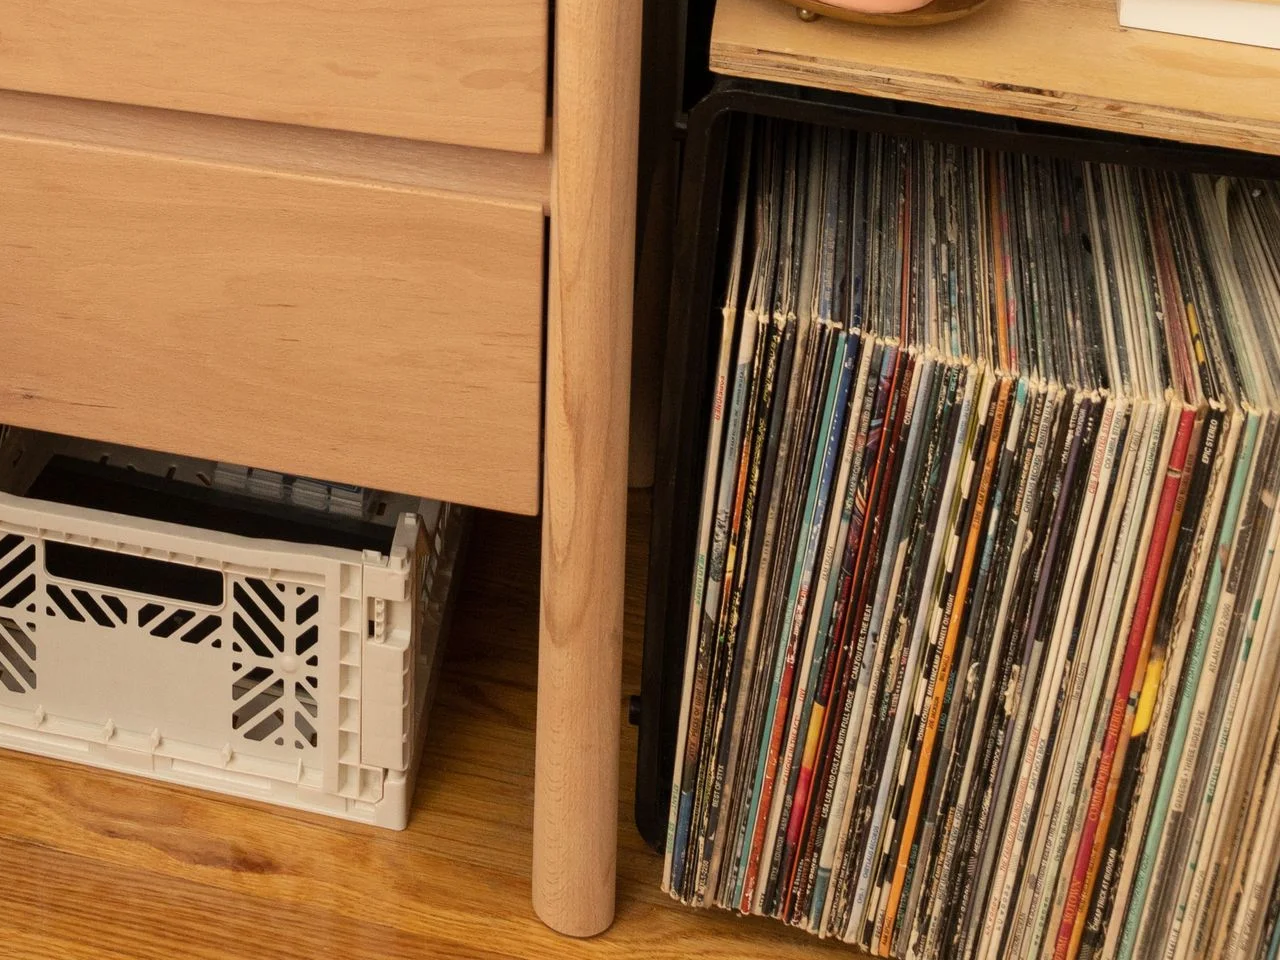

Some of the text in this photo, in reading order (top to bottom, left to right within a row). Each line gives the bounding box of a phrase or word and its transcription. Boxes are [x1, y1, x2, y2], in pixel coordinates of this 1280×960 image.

[1028, 423, 1038, 442] MADE
[1030, 453, 1041, 480] RECORDS
[1037, 422, 1048, 448] PRINTED
[1060, 428, 1074, 463] COLUMBIA
[1087, 406, 1113, 493] CBS ASSOCIATED STEREO
[1103, 409, 1123, 469] COLUMBIA STEREO
[1200, 417, 1218, 464] EPIC STEREO
[860, 621, 868, 634] THE
[862, 603, 872, 621] BEAT
[853, 650, 862, 665] YOU
[856, 634, 865, 650] FEEL
[1207, 637, 1223, 673] ATLANTIC
[916, 719, 926, 740] JOHN
[926, 655, 940, 695] MELLENCAMP
[936, 626, 947, 649] LONELY
[944, 593, 954, 614] NIGHT
[983, 738, 995, 769] HOWARD
[1006, 628, 1019, 660] ACTION
[821, 689, 854, 818] LISA LISA AND CULT JAM WITH FULL FORCE
[1032, 754, 1041, 772] HOLD
[1036, 737, 1045, 755] BACK
[1087, 753, 1112, 821] COMMODORES
[1107, 696, 1125, 736] HEROES
[1174, 709, 1205, 808] GENESIS THREE SIDES LIVE
[711, 762, 724, 807] BEST OF STYX
[1021, 800, 1031, 822] MONEY
[1016, 822, 1026, 841] EDDIE
[770, 866, 778, 880] STYX
[1090, 846, 1117, 931] CHEAP TRICK AT BUDOKAN
[1062, 878, 1081, 924] MOTOWN
